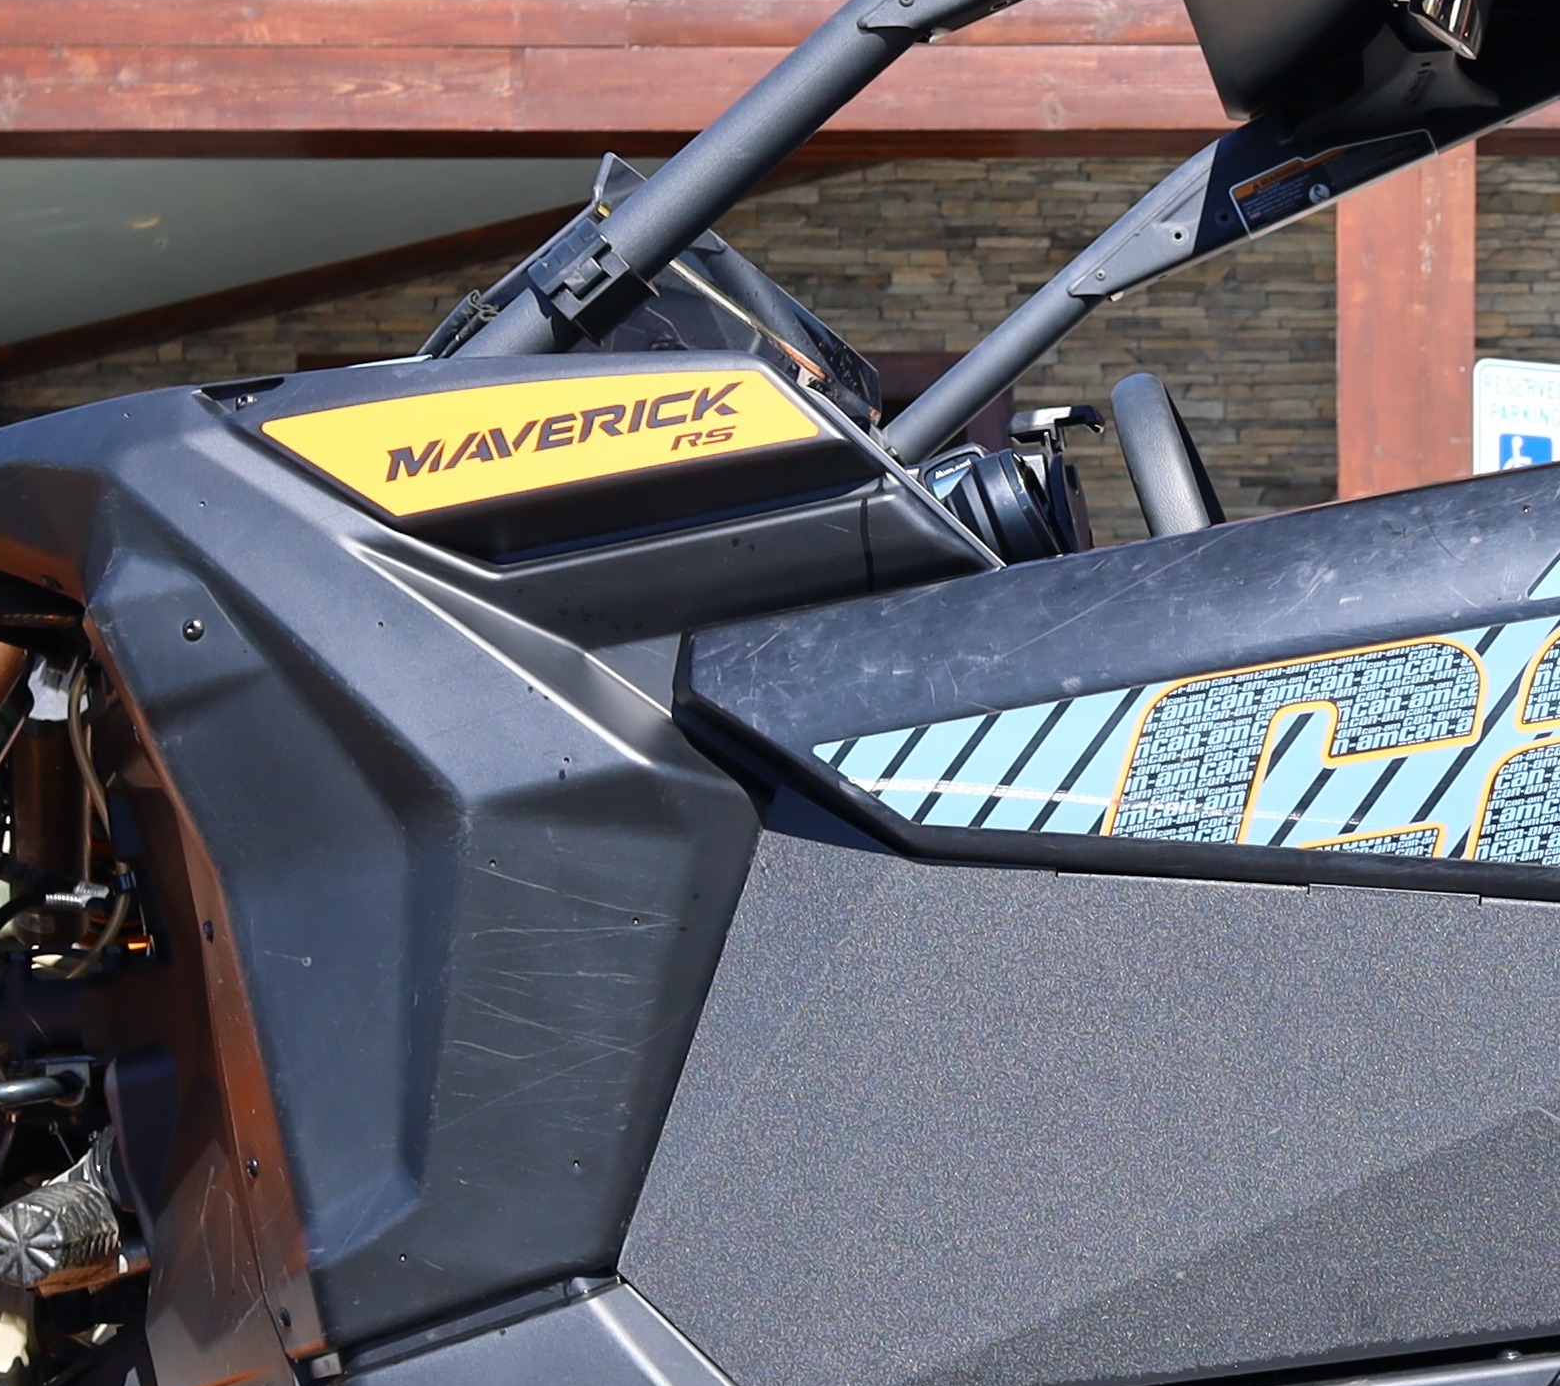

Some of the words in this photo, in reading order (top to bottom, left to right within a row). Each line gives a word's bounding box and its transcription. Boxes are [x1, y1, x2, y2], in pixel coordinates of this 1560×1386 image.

[1491, 403, 1560, 428] PARKING
[385, 380, 744, 483] MAVERICK
[670, 425, 736, 451] RS
[1202, 683, 1304, 713] can-am
[1302, 664, 1404, 695] can-am
[1207, 679, 1267, 697] can-am
[1307, 661, 1367, 678] can-am
[1350, 688, 1452, 718] can-am
[1354, 684, 1414, 702] can-am
[1153, 721, 1214, 738] can-am
[1401, 708, 1461, 726] can-am
[1149, 724, 1251, 754] can-am
[1203, 744, 1262, 762] can-am
[1144, 791, 1245, 821] can-am
[1148, 787, 1208, 805] can-am
[1494, 824, 1553, 841] can-am
